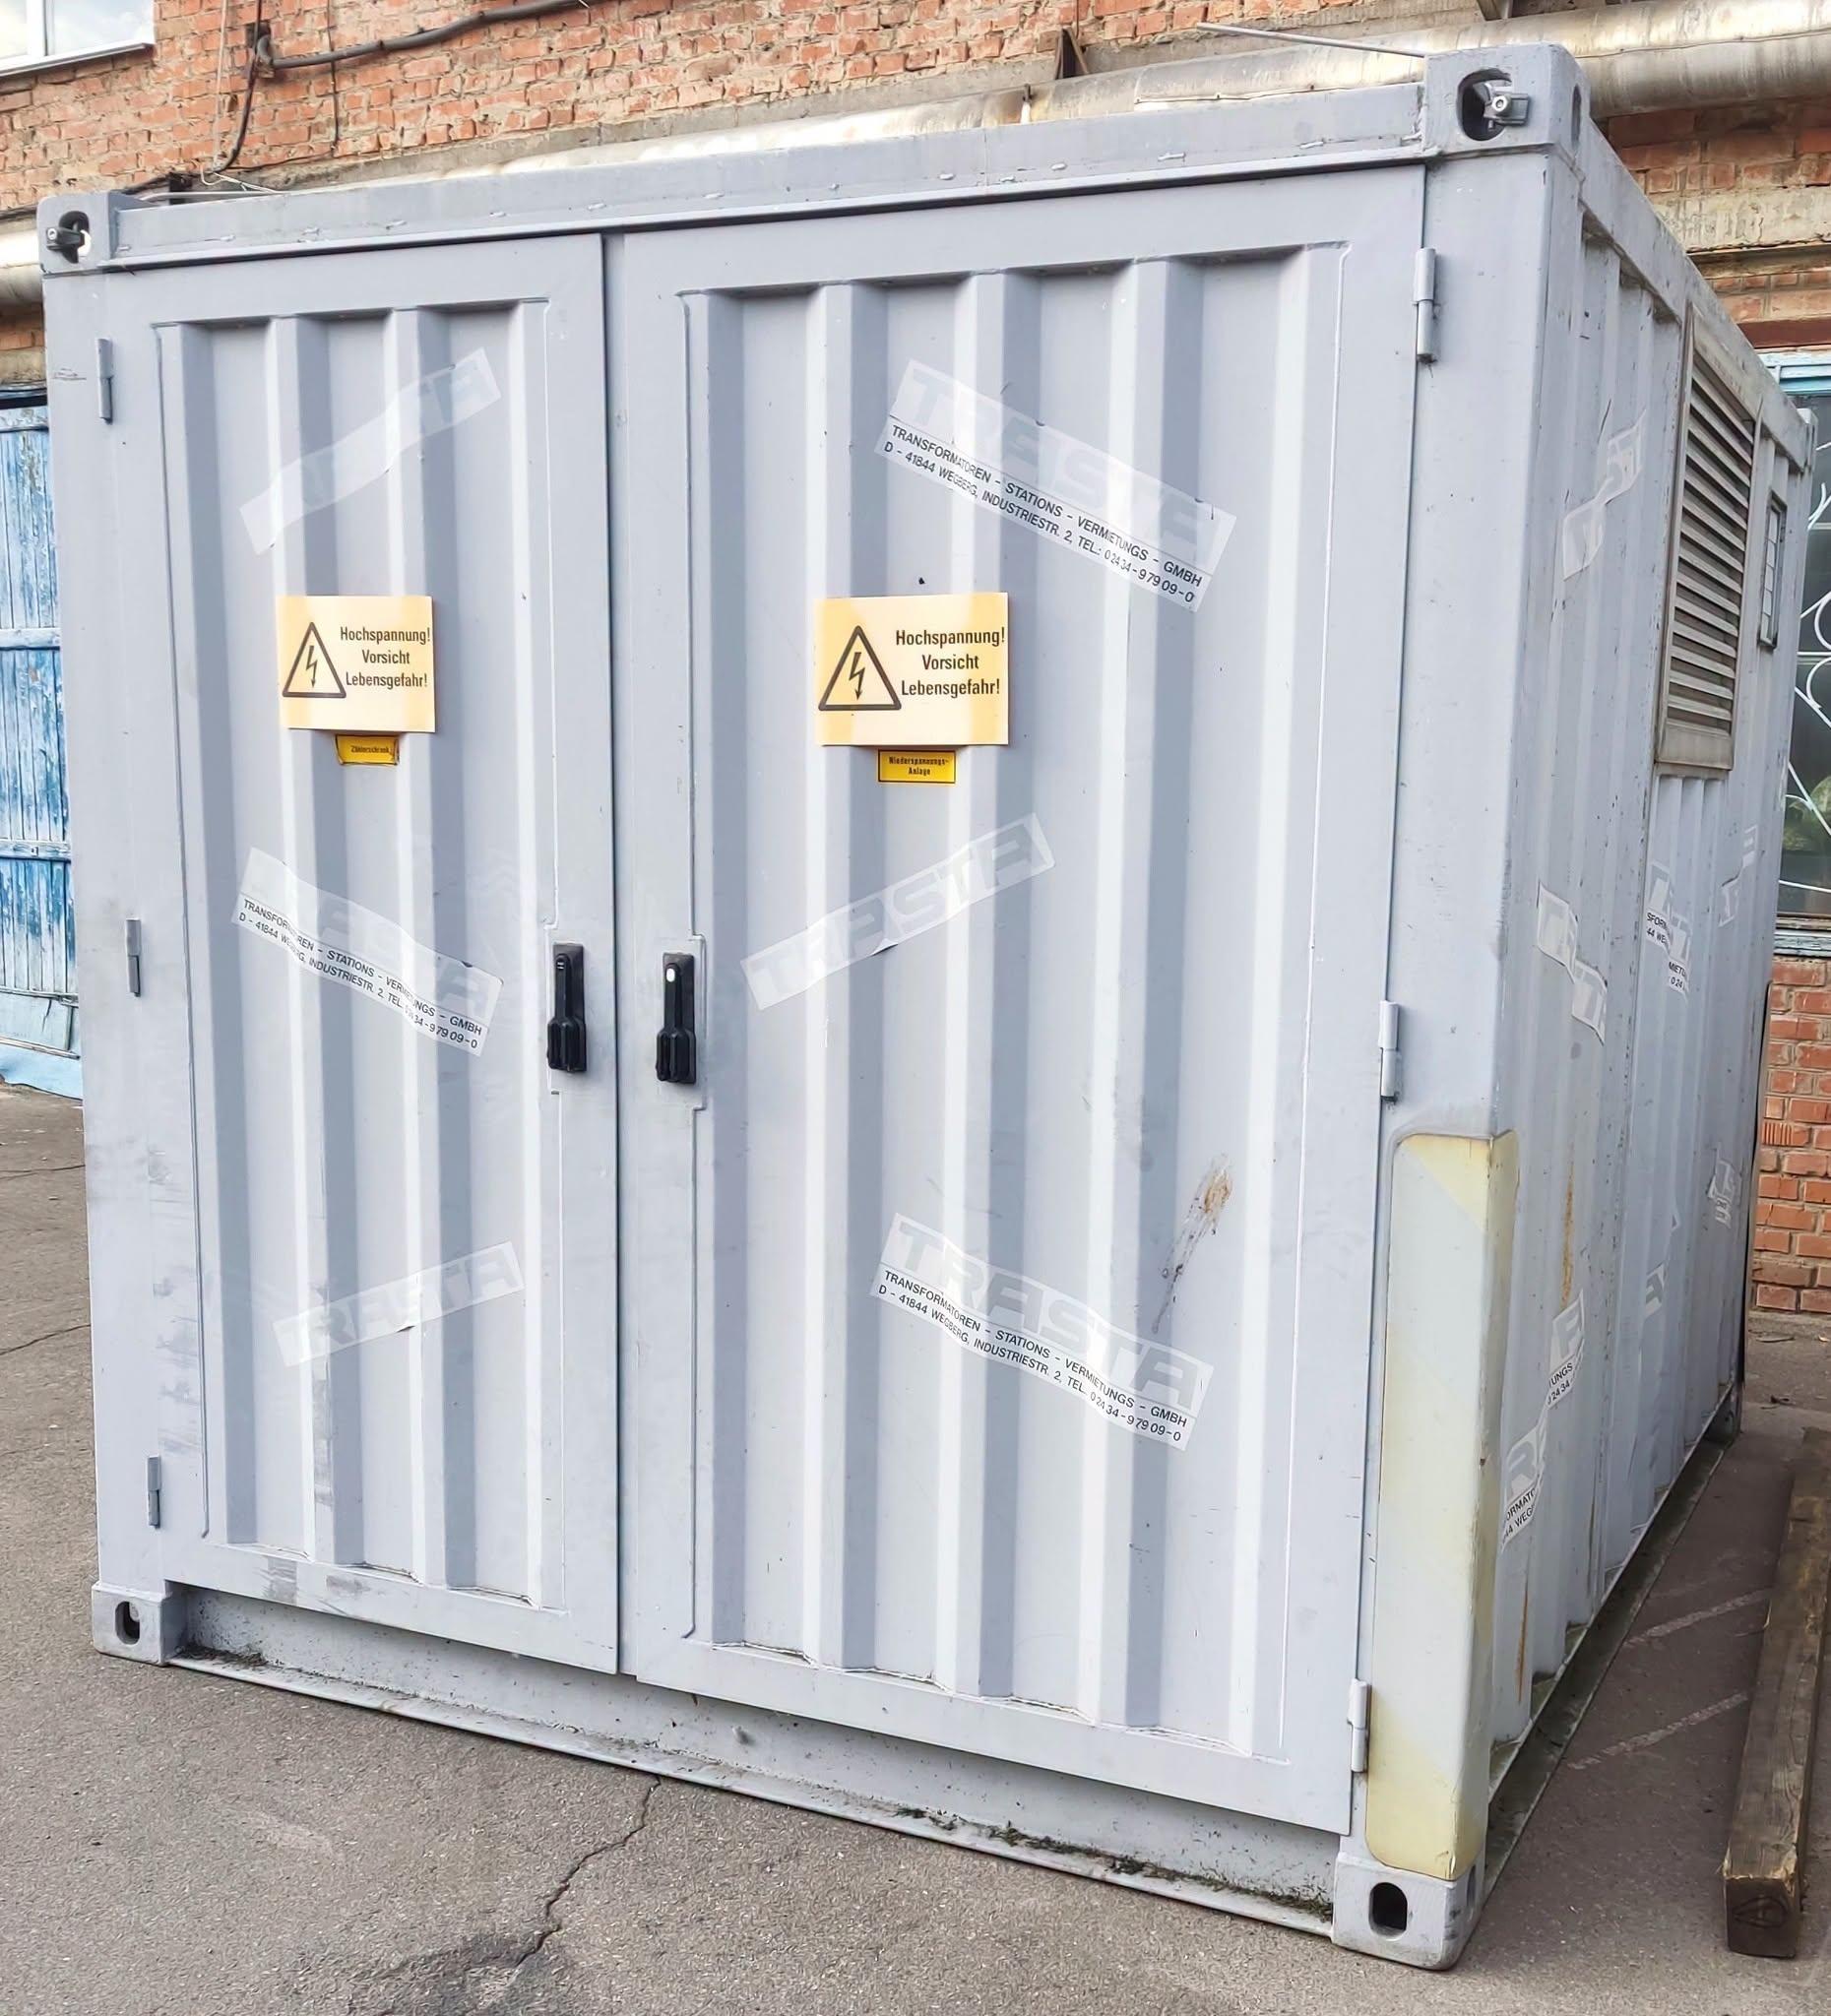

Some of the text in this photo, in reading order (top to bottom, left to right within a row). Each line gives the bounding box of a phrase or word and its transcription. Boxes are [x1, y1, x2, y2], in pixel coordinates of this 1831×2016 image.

[884, 441, 894, 453] D
[905, 451, 935, 472] 41844
[981, 490, 1060, 536] INDUSTRIESTR.
[892, 424, 991, 482] TRANSFORMATOREN
[1005, 482, 1063, 518] STATIONS
[1078, 516, 1150, 561] VERMIETUNGS
[1164, 561, 1203, 587] GMBH
[340, 626, 431, 646] Hochspannung!
[896, 626, 1005, 649] Hochspannung!
[361, 650, 410, 664] Vorsicht
[921, 654, 979, 670] Vorsicht
[346, 671, 428, 690] Lebensgefahr!
[901, 678, 1000, 699] Lebensgefahr!
[908, 767, 931, 777] Anlage
[238, 912, 246, 922] D
[255, 920, 279, 938] 41844
[327, 950, 374, 978] STATIONS
[450, 1016, 482, 1037] GMBH
[899, 1221, 1199, 1412] TRASTA
[878, 1285, 887, 1295] D
[899, 1294, 928, 1314] 41844
[974, 1337, 1050, 1376] INDUSTRIESTR.
[885, 1270, 981, 1332] TRANSFORMATOREN
[995, 1329, 1051, 1359] STATIONS
[1065, 1357, 1135, 1409] VERMIETUNGS
[1151, 1406, 1188, 1428] GMBH
